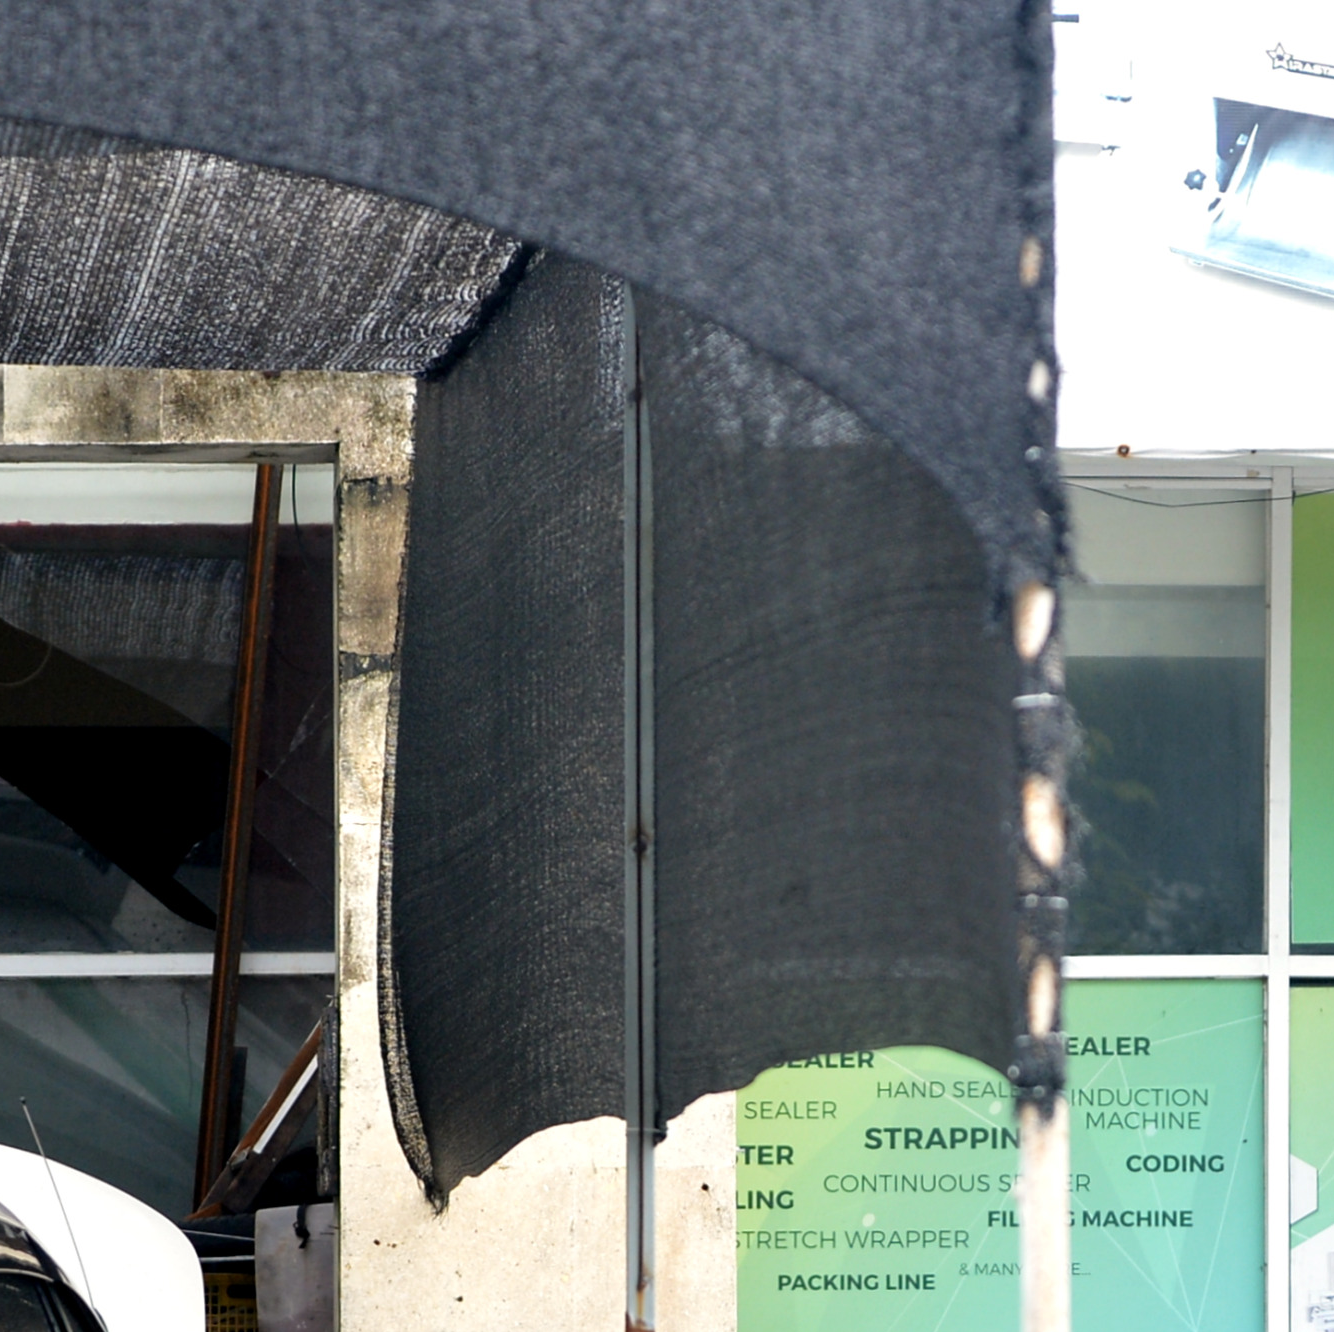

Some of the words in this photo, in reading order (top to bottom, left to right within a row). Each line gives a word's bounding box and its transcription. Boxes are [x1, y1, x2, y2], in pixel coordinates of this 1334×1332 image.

[1065, 1036, 1151, 1056] EALER
[877, 1081, 945, 1098] HAND
[1072, 1089, 1208, 1106] INDUCTION
[744, 1101, 836, 1119] SEALER
[1086, 1112, 1200, 1129] MACHINE
[864, 1127, 1020, 1150] STRAPPIN
[1126, 1155, 1224, 1172] CODING
[824, 1174, 990, 1193] CONTINUOUS
[1083, 1211, 1192, 1227] MACHINE
[845, 1230, 969, 1248] WRAPPER
[778, 1275, 878, 1290] PACKING
[886, 1274, 935, 1290] LINE
